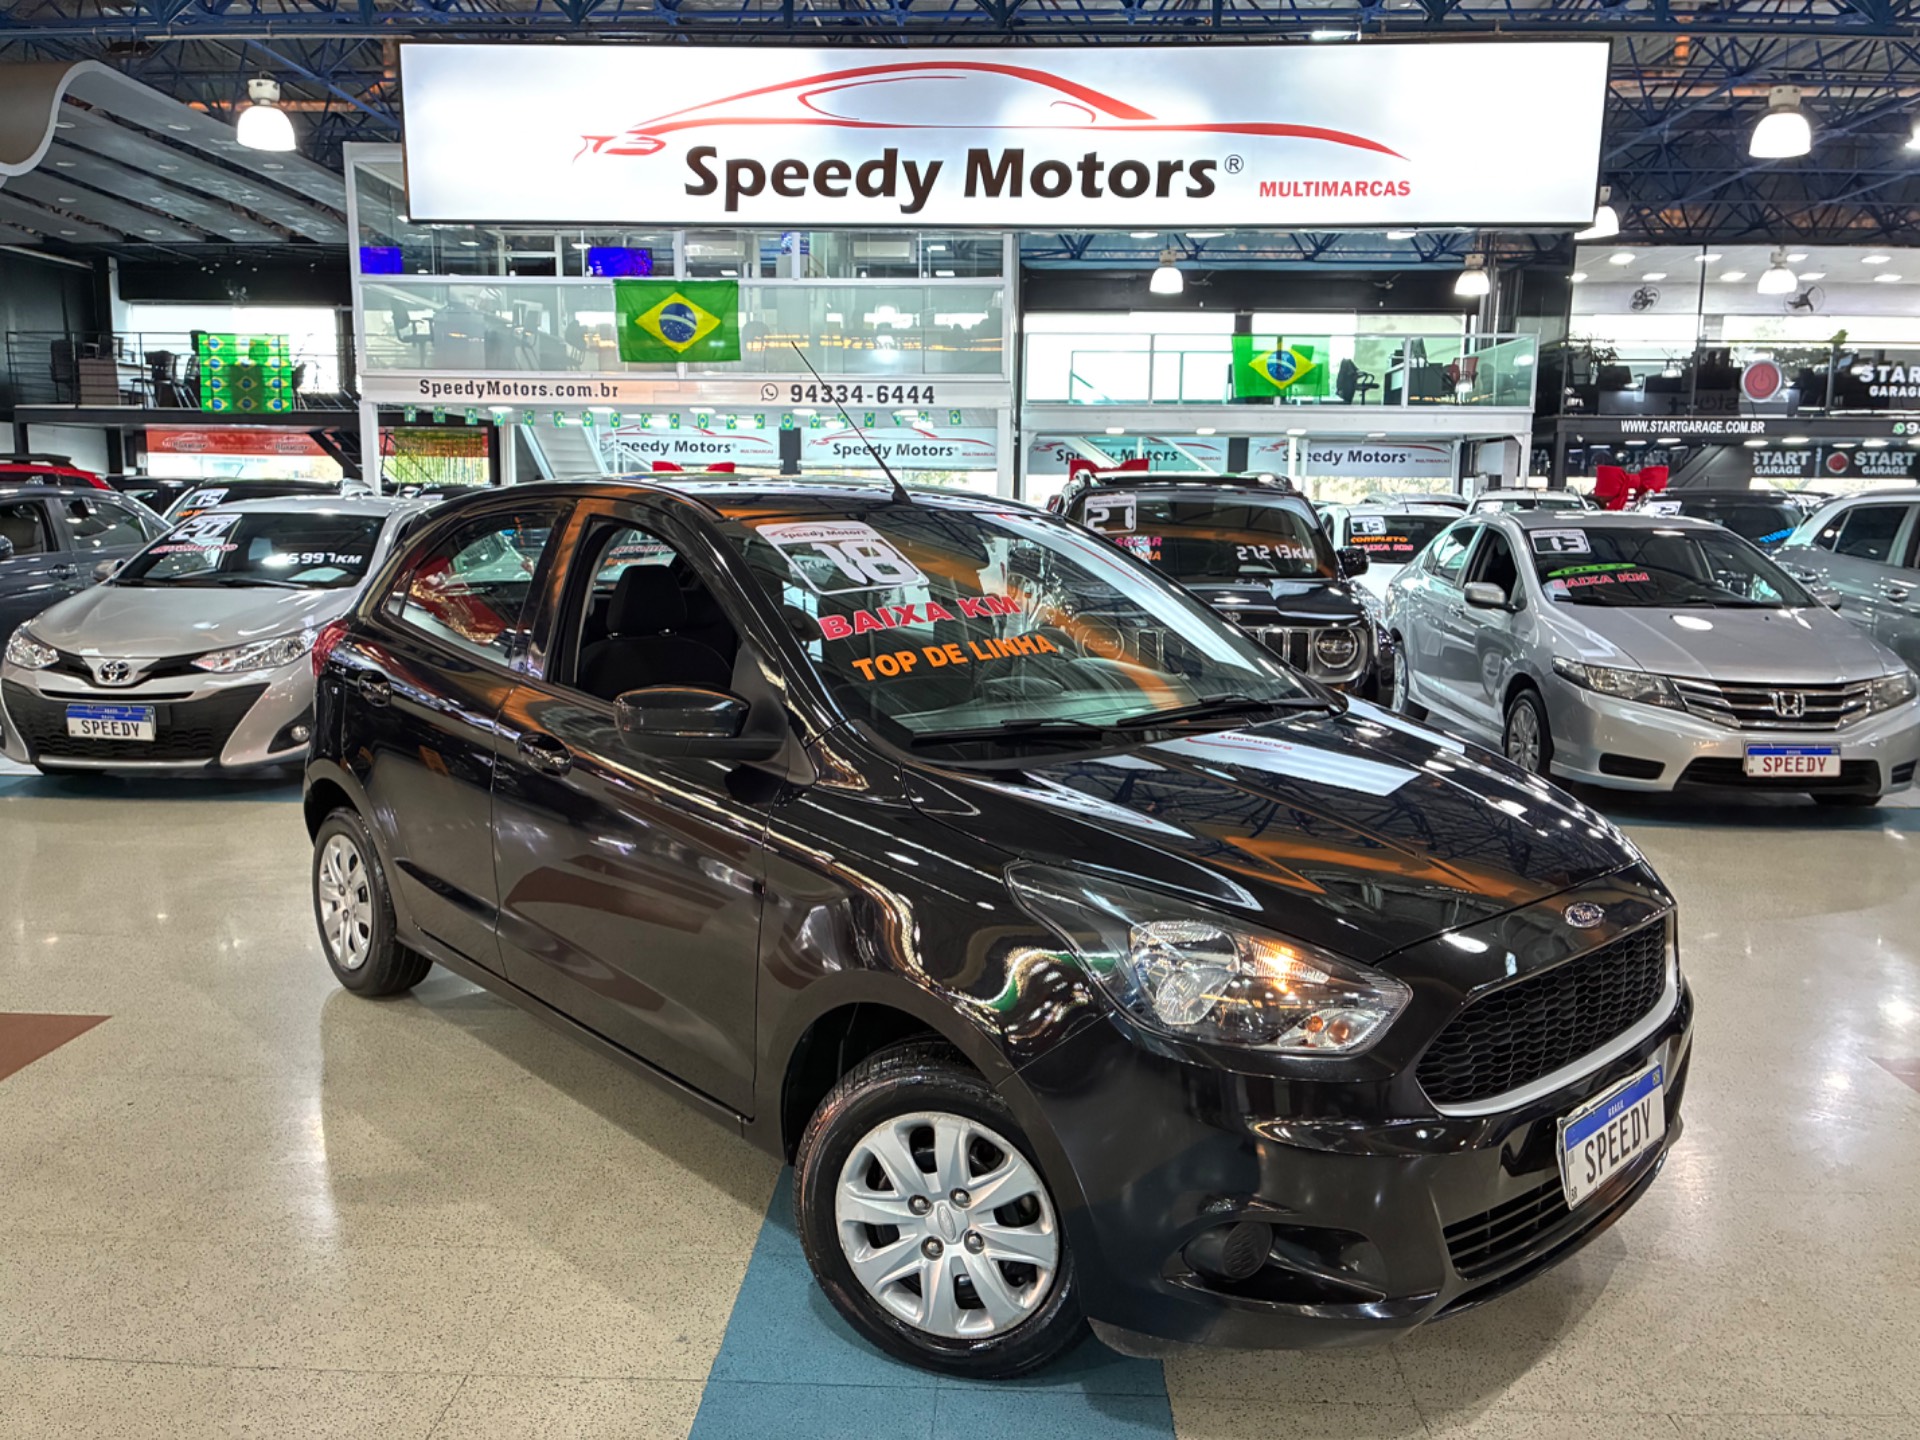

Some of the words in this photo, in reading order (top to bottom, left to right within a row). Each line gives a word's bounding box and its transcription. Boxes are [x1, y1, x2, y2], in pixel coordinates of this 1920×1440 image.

[684, 145, 944, 214] Speedy
[1259, 180, 1411, 197] MULTIMARCAS
[419, 378, 619, 399] SpeedyMotors.com.br
[790, 384, 936, 405] 94334-6444
[1869, 386, 1920, 397] GARAG
[1621, 420, 1766, 434] WWW.STARTGARAGE.COM.BR
[674, 441, 732, 454] Motors
[832, 443, 892, 459] Speedy
[896, 444, 954, 456] Motors
[1347, 450, 1407, 463] Motors
[1854, 452, 1917, 465] START
[1755, 466, 1802, 474] GARAGE
[1861, 466, 1908, 475] GARAGE
[1088, 507, 1133, 533] 21
[1351, 535, 1409, 544] COMPLETO
[1550, 536, 1587, 551] 13
[810, 541, 922, 584] 18
[1552, 575, 1614, 589] BAIXA
[1616, 572, 1650, 583] KM
[818, 600, 955, 641] BAIXA
[956, 596, 1022, 618] KM
[852, 651, 918, 682] TOP
[923, 643, 969, 668] DE
[968, 634, 1058, 661] LINHA
[81, 719, 140, 737] SPEEDY
[1762, 757, 1827, 772] SPEEDY
[1584, 1097, 1651, 1184] SPEEDY
